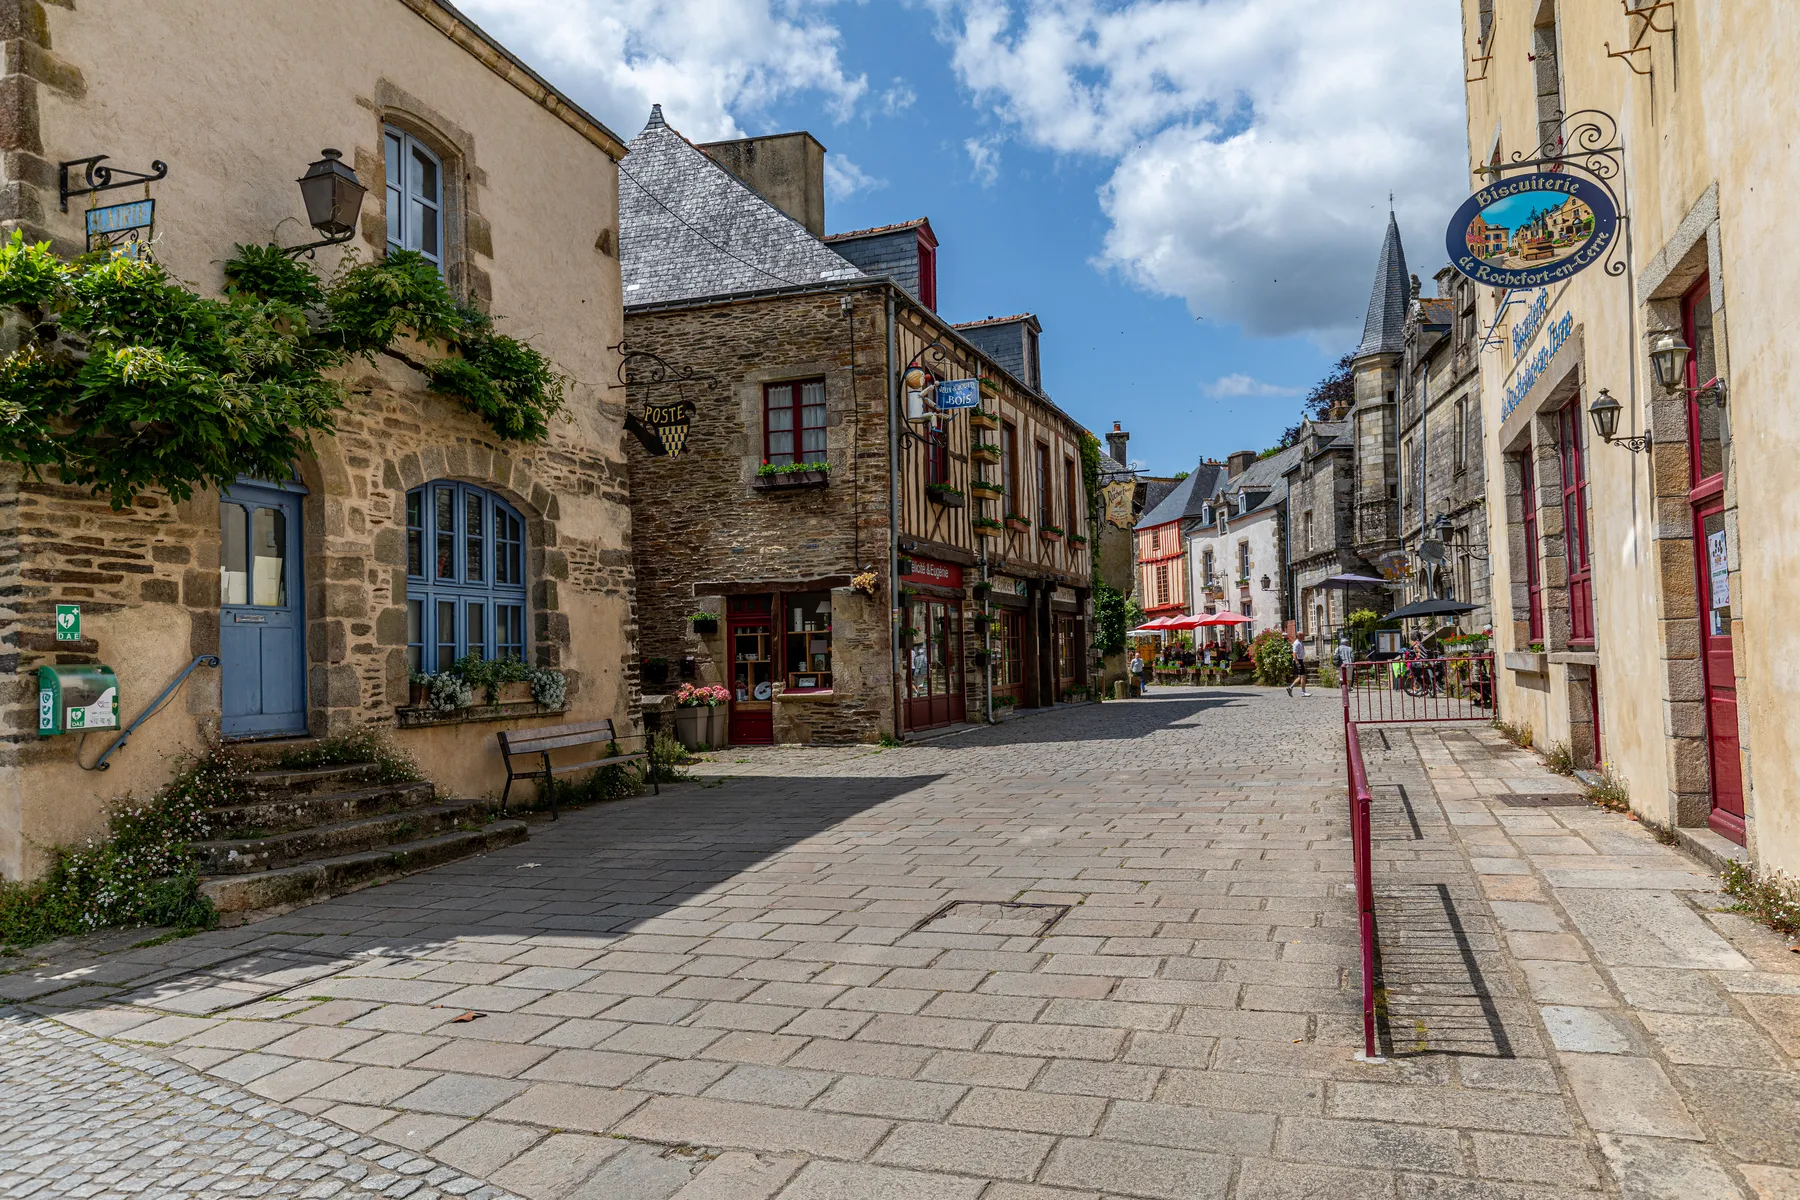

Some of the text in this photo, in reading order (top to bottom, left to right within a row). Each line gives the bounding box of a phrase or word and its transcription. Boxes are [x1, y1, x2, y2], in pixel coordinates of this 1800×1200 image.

[1475, 176, 1580, 208] Biscuiterie
[89, 203, 149, 231] MAIRIE
[1458, 231, 1610, 286] de Rochefort-en-Terre
[644, 405, 685, 423] POSTE
